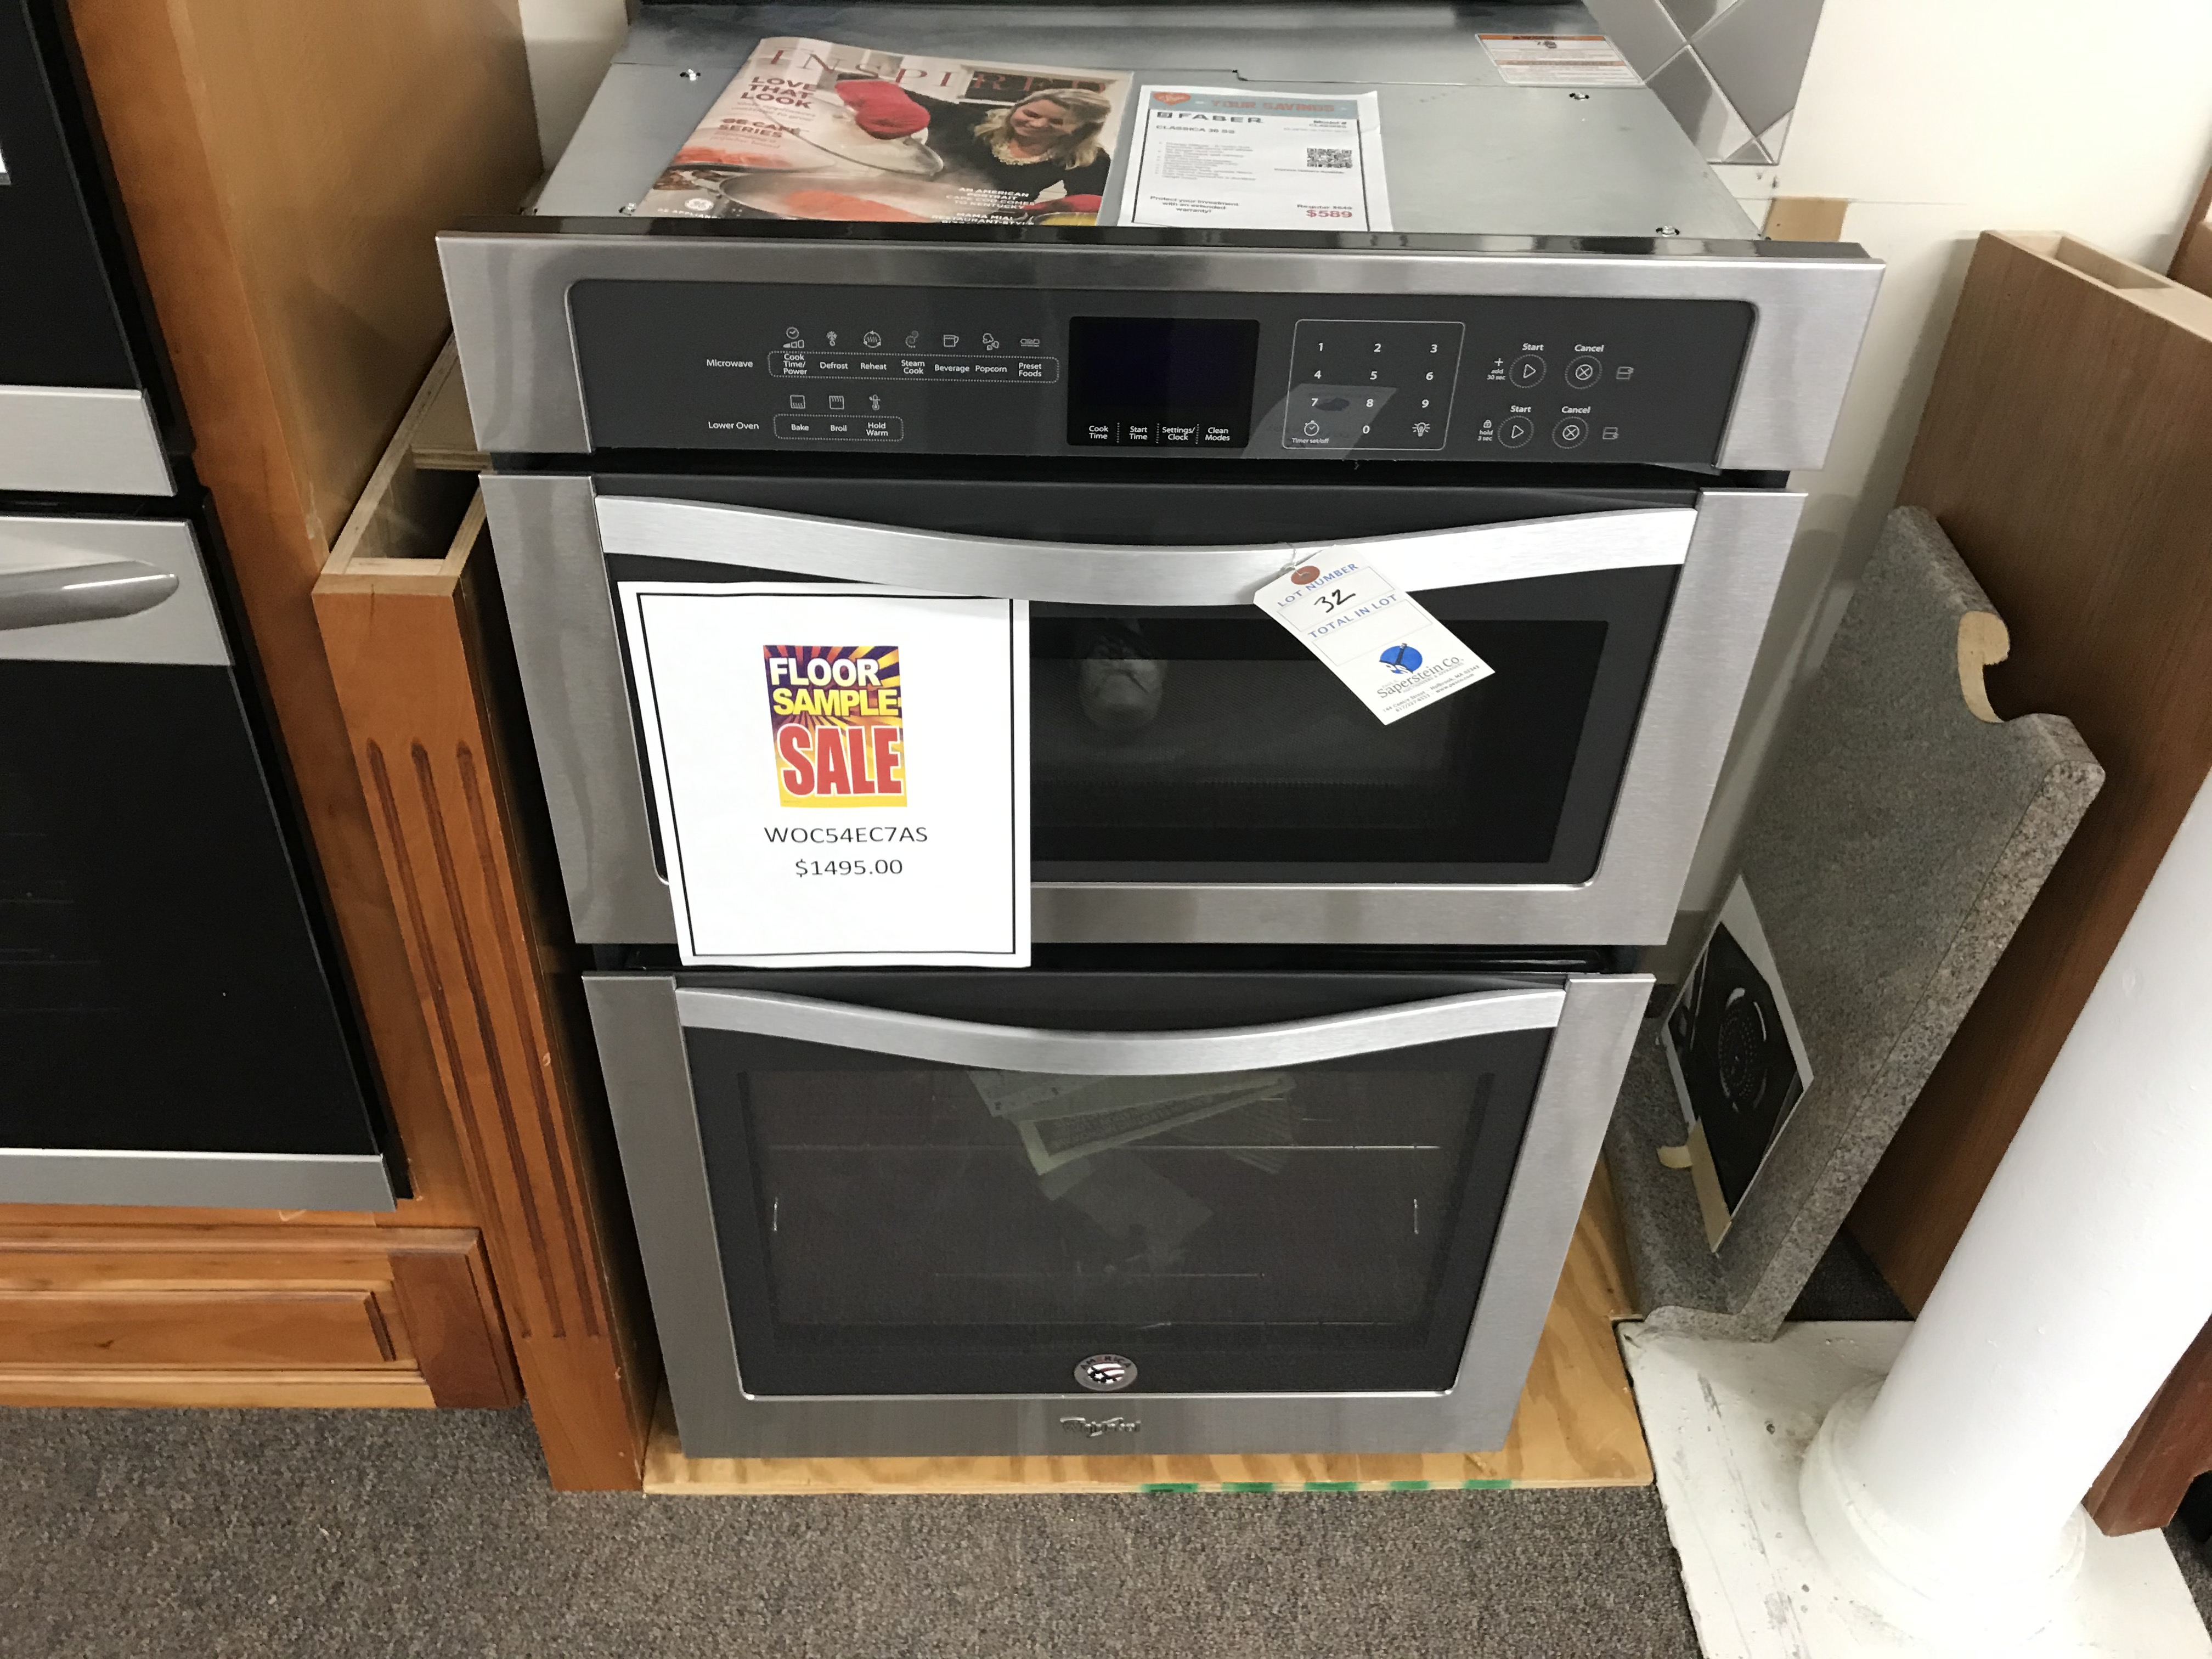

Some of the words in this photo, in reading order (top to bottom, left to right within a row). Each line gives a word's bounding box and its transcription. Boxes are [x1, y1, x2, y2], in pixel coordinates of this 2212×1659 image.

[752, 77, 817, 92] LOVE
[748, 84, 815, 99] THAT
[741, 92, 812, 109] LOOK
[1212, 100, 1256, 109] YOUR
[1263, 103, 1335, 111] SAVINGS
[1179, 113, 1263, 124] FABER
[718, 125, 782, 138] SERIES
[975, 189, 1030, 198] AMERICAN
[970, 201, 1025, 210] KENTUCKY
[1306, 210, 1353, 218] $589
[1319, 343, 1323, 351] 1
[1374, 343, 1381, 352] 2
[1430, 345, 1437, 353] 3
[783, 368, 808, 376] Power
[935, 364, 969, 373] Beverage
[1314, 370, 1321, 379] 4
[1370, 371, 1377, 380] 5
[1426, 372, 1433, 380] 6
[1367, 399, 1373, 407] 8
[1422, 399, 1429, 408] 9
[1363, 425, 1370, 433] 0
[1277, 592, 1301, 607] LOT
[1305, 563, 1359, 590] NUMBER
[1314, 589, 1356, 613] 32
[1308, 615, 1353, 639] TOTAL
[1355, 606, 1370, 618] IN
[1374, 594, 1397, 610] LOT
[769, 657, 882, 687] FLOOR
[1376, 664, 1444, 698] Saperstein
[772, 687, 899, 716] SAMPLE
[777, 724, 904, 797] SALE
[764, 827, 928, 843] WOC54EC7AS
[795, 858, 903, 878] $1495.00
